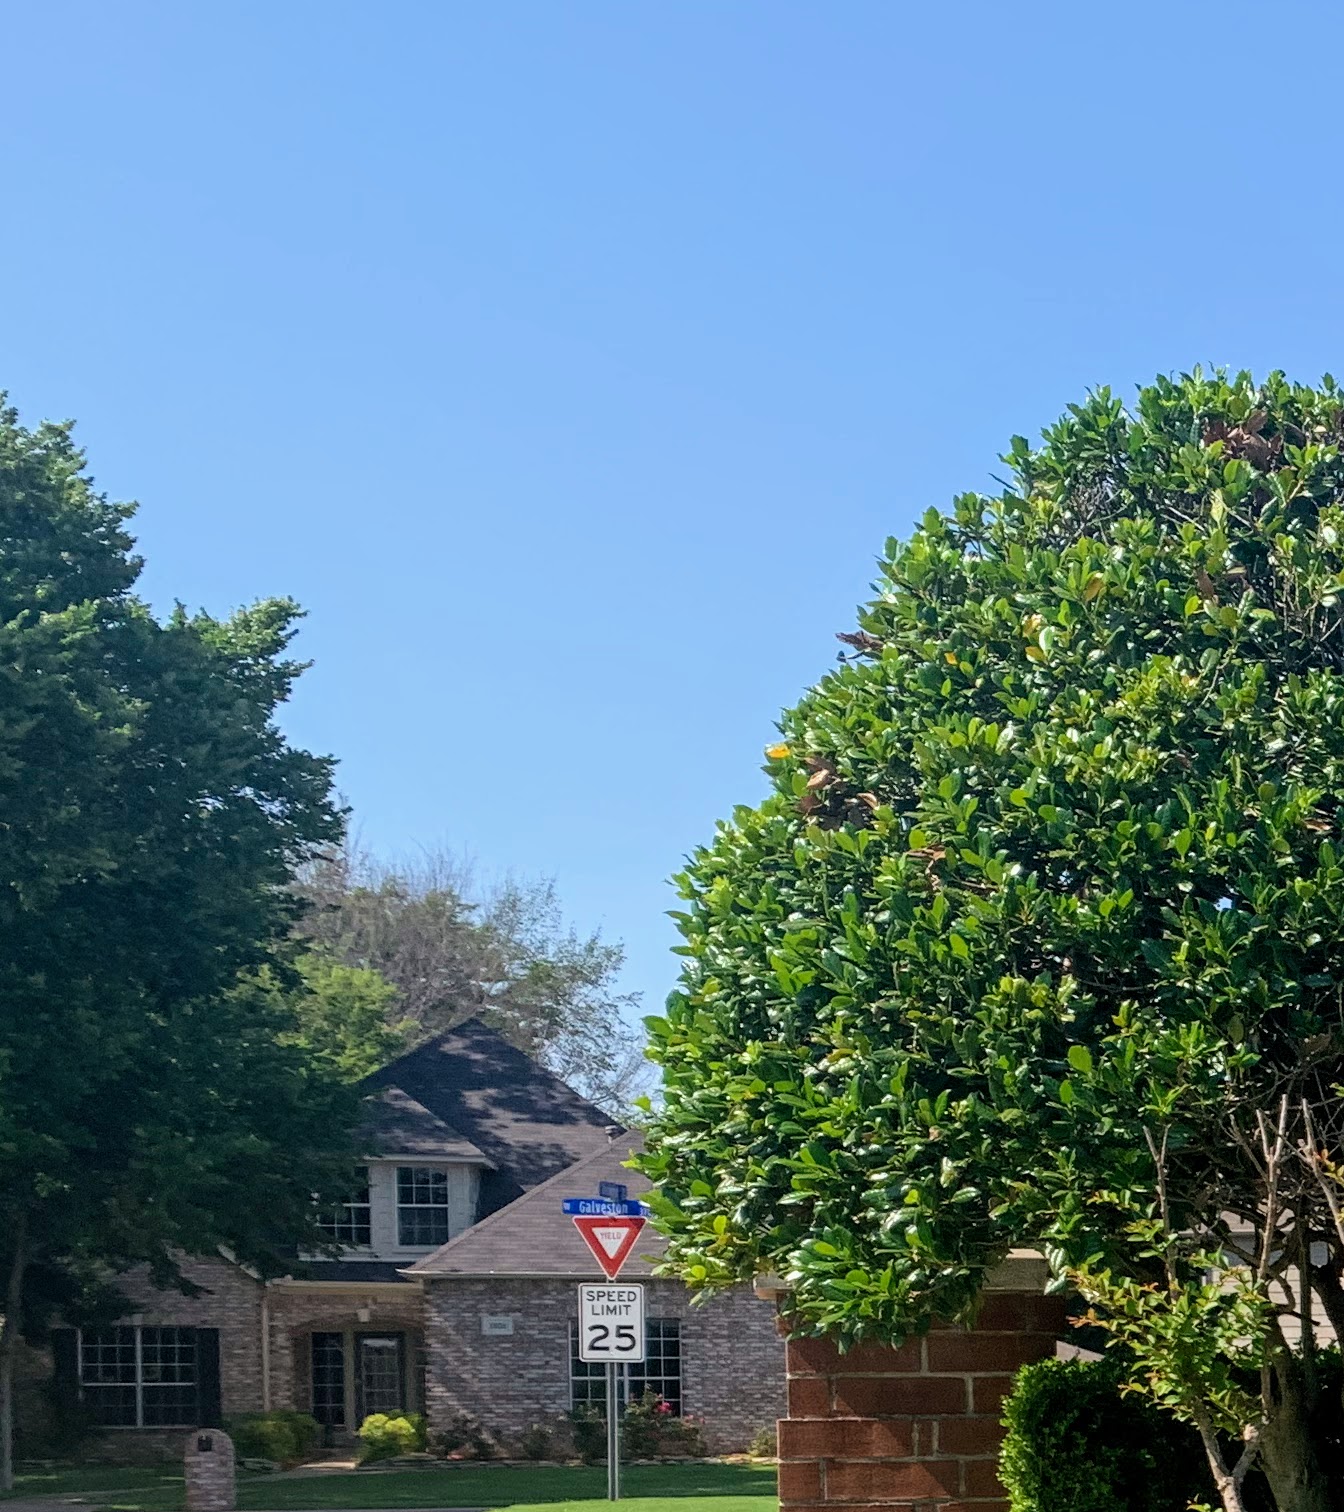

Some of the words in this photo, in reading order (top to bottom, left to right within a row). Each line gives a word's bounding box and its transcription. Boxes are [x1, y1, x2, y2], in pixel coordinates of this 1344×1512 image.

[579, 1200, 628, 1213] Galveston
[586, 1290, 637, 1302] SPEED
[591, 1304, 631, 1316] LIMIT
[588, 1325, 636, 1351] 25
